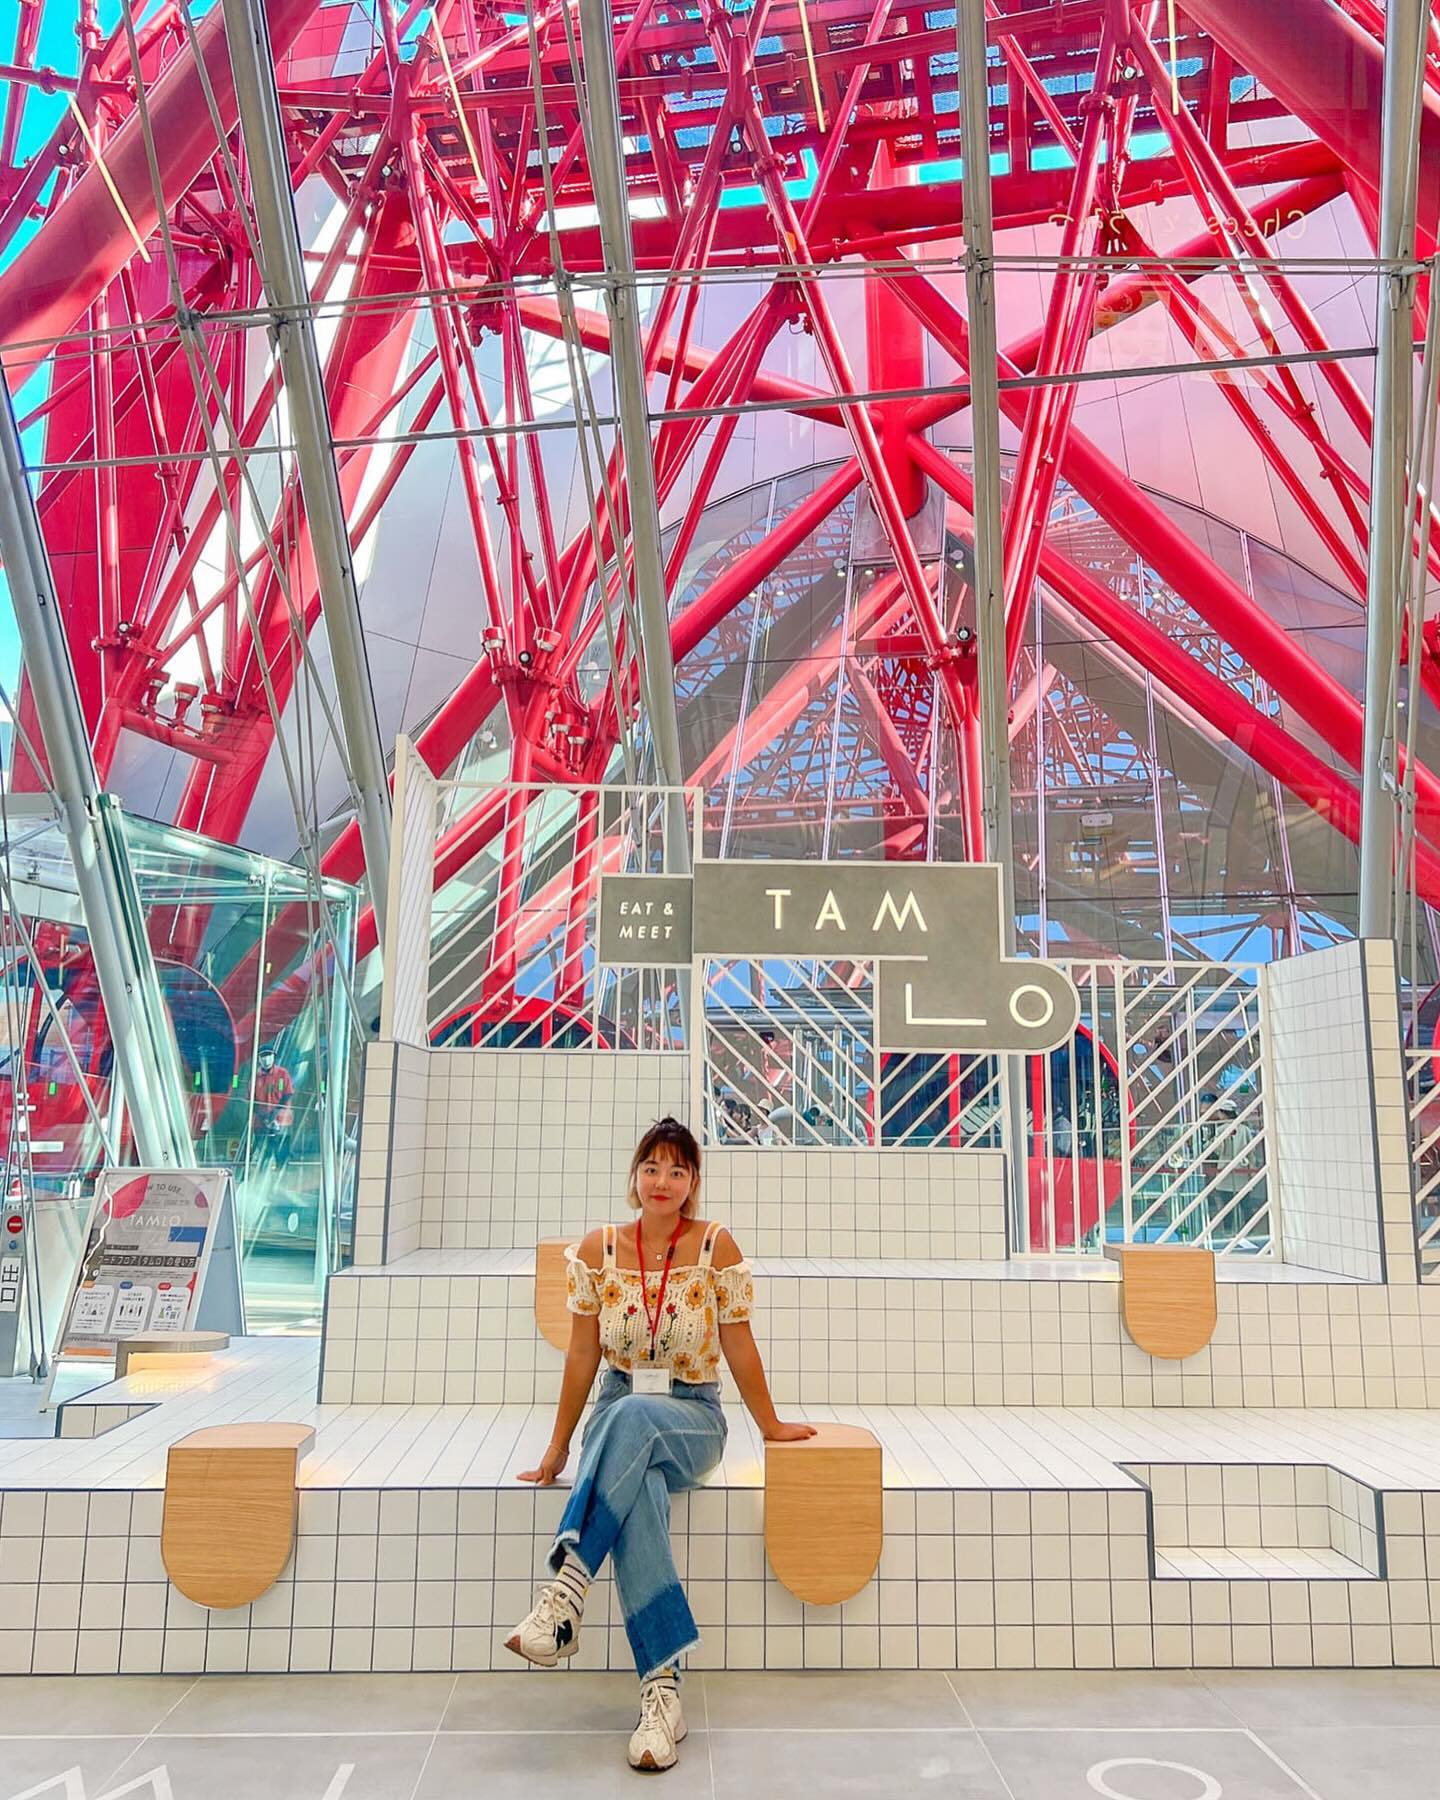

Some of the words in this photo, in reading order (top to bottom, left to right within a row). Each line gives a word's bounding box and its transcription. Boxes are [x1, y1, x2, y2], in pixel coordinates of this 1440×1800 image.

[619, 901, 654, 915] EAT
[663, 902, 674, 916] &
[765, 888, 928, 932] TAM
[619, 925, 673, 939] MEET
[905, 982, 1054, 1028] LO
[129, 1214, 181, 1227] TAMLO
[0, 1263, 19, 1303] 出口
